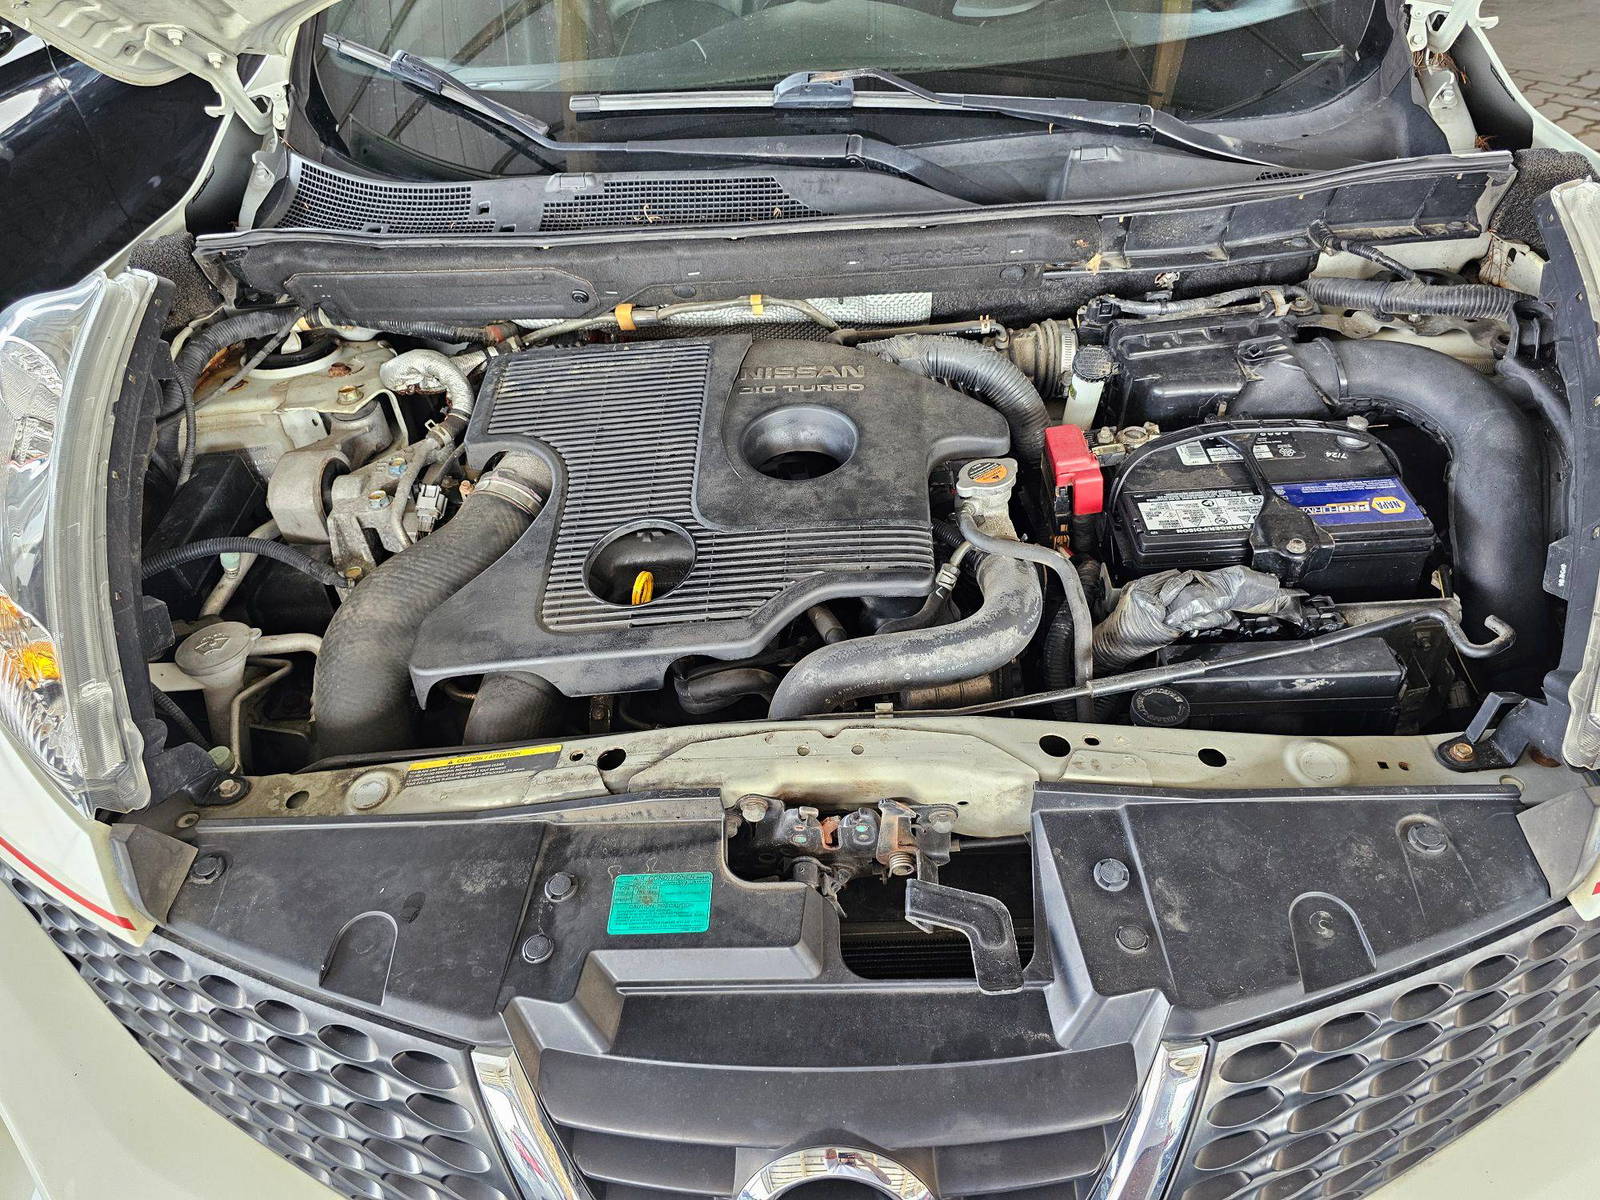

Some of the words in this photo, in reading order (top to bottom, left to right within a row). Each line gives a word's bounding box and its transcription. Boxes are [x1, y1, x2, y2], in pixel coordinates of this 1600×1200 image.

[740, 365, 865, 381] NISSAN
[782, 383, 865, 393] TURBO
[1376, 500, 1401, 510] NAPA
[489, 751, 521, 759] ATTENTION
